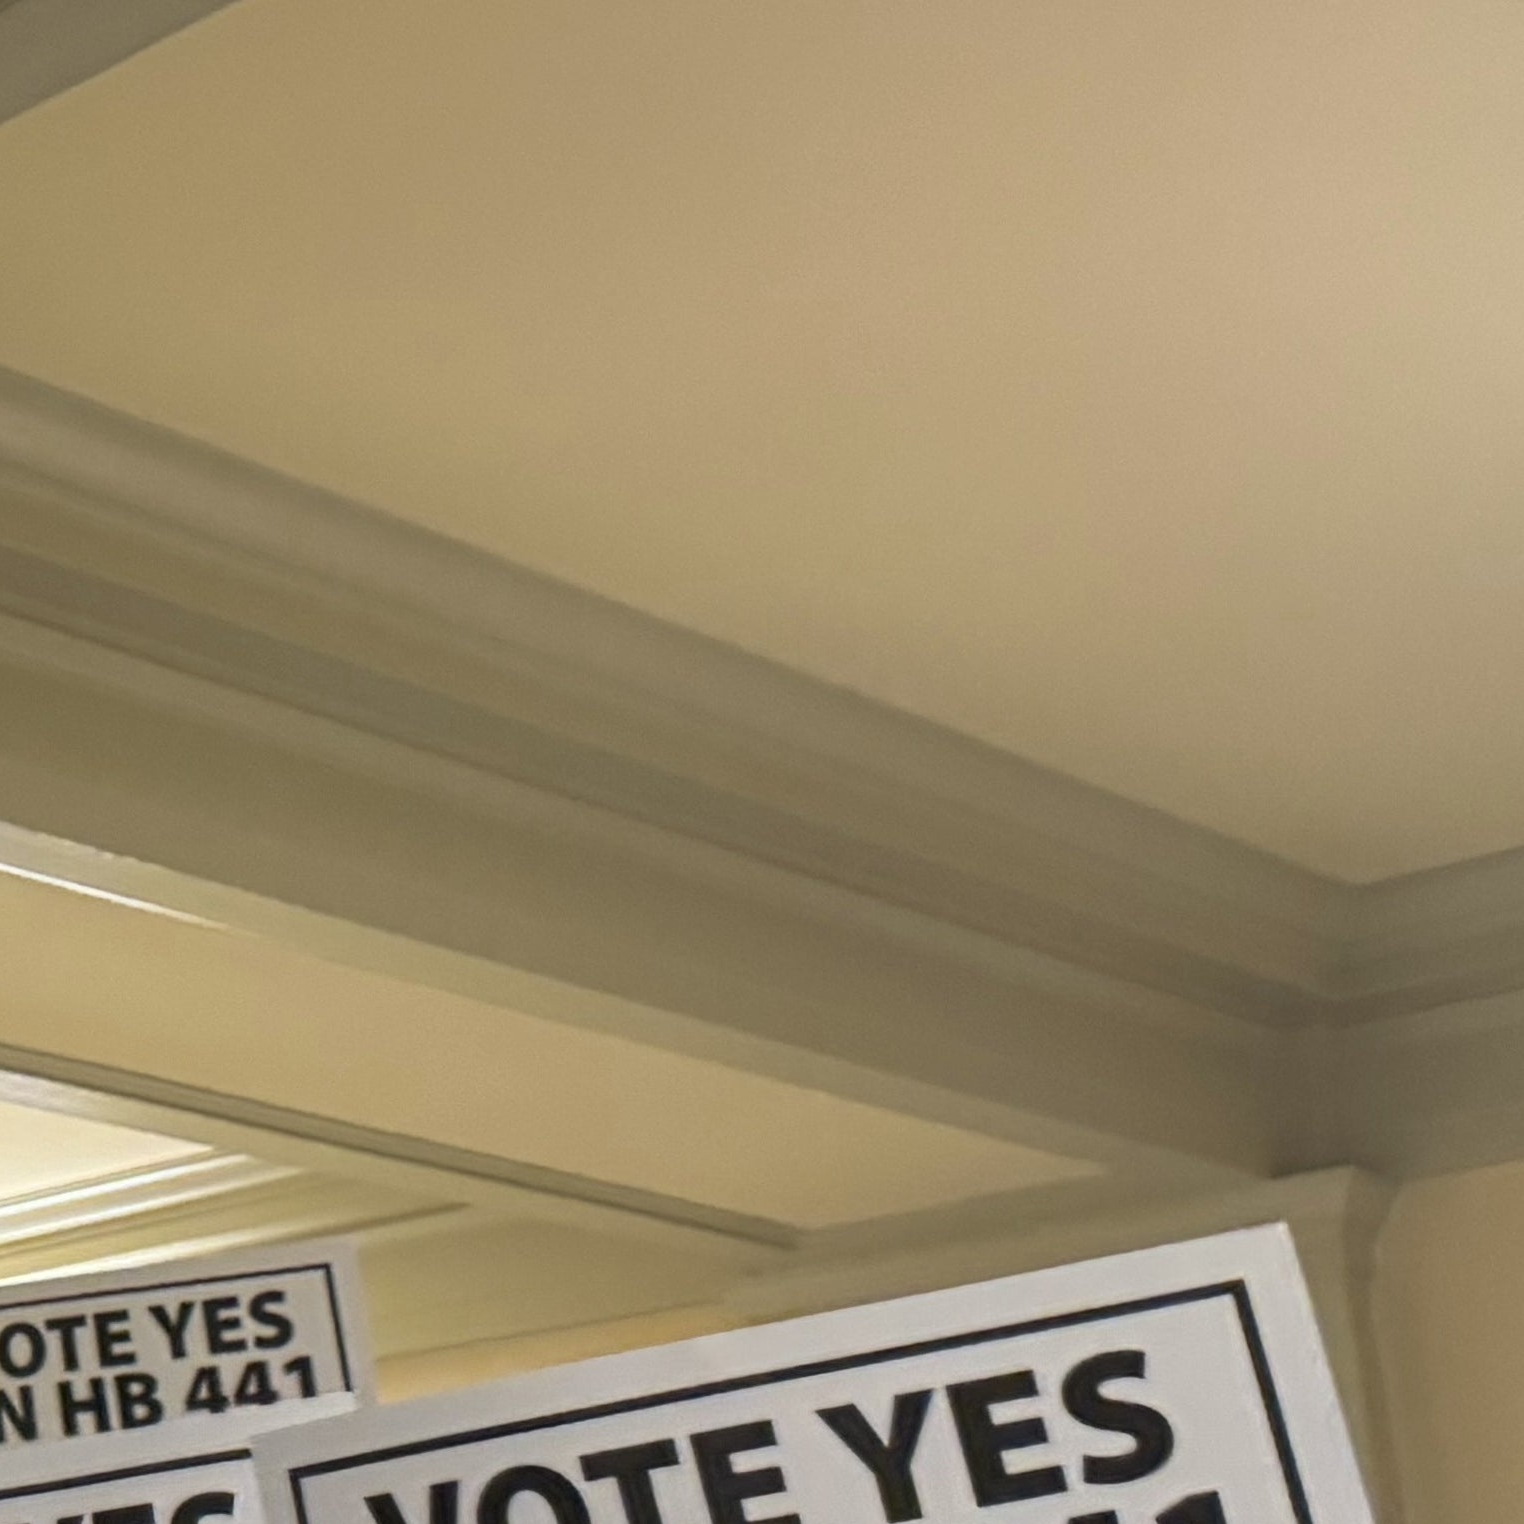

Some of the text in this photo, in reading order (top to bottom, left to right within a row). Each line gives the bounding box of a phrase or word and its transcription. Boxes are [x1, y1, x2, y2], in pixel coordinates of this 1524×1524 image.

[148, 1288, 295, 1362] YES
[60, 1370, 164, 1438] HB
[185, 1354, 319, 1413] 441
[817, 1347, 1177, 1524] YES
